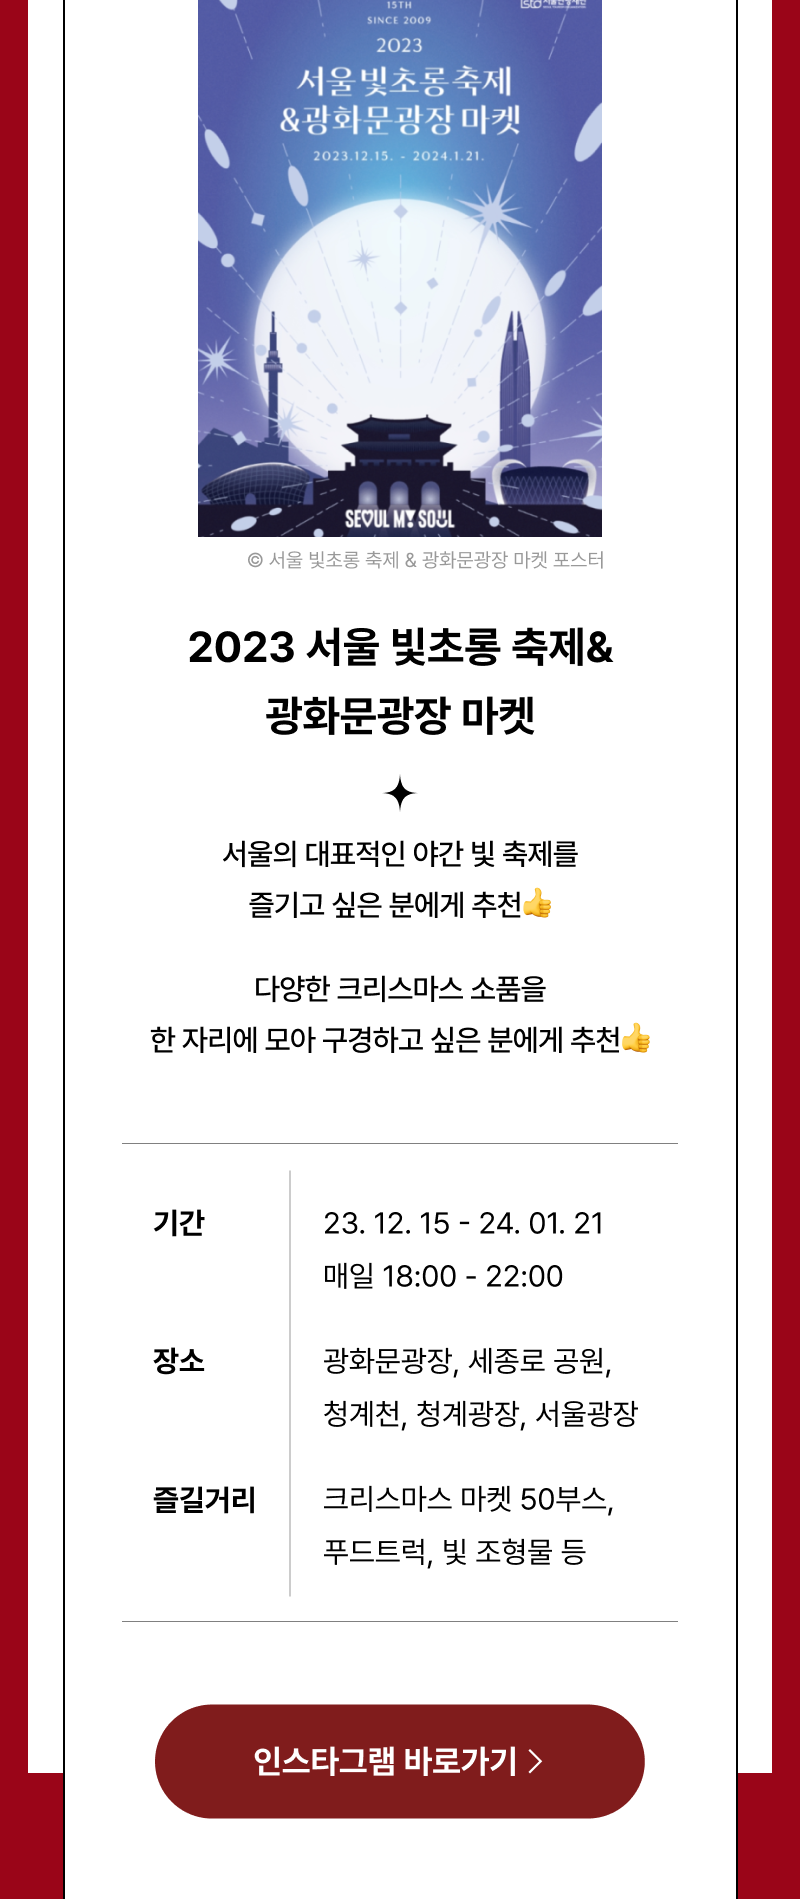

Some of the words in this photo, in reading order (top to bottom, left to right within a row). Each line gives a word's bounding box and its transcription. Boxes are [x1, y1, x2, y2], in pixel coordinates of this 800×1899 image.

[387, 0, 412, 9] 15TH
[367, 16, 398, 25] SINCE
[403, 16, 432, 25] 2009
[376, 37, 423, 53] 2023
[296, 65, 356, 97] 서울
[361, 65, 450, 97] 빛초롱
[451, 64, 512, 97] 축제
[280, 104, 455, 136] &광화문광장
[461, 104, 520, 135] 마켓
[313, 150, 394, 162] 2023.12.15.
[413, 150, 485, 162] 2024.1.21.
[418, 509, 455, 528] SOUL
